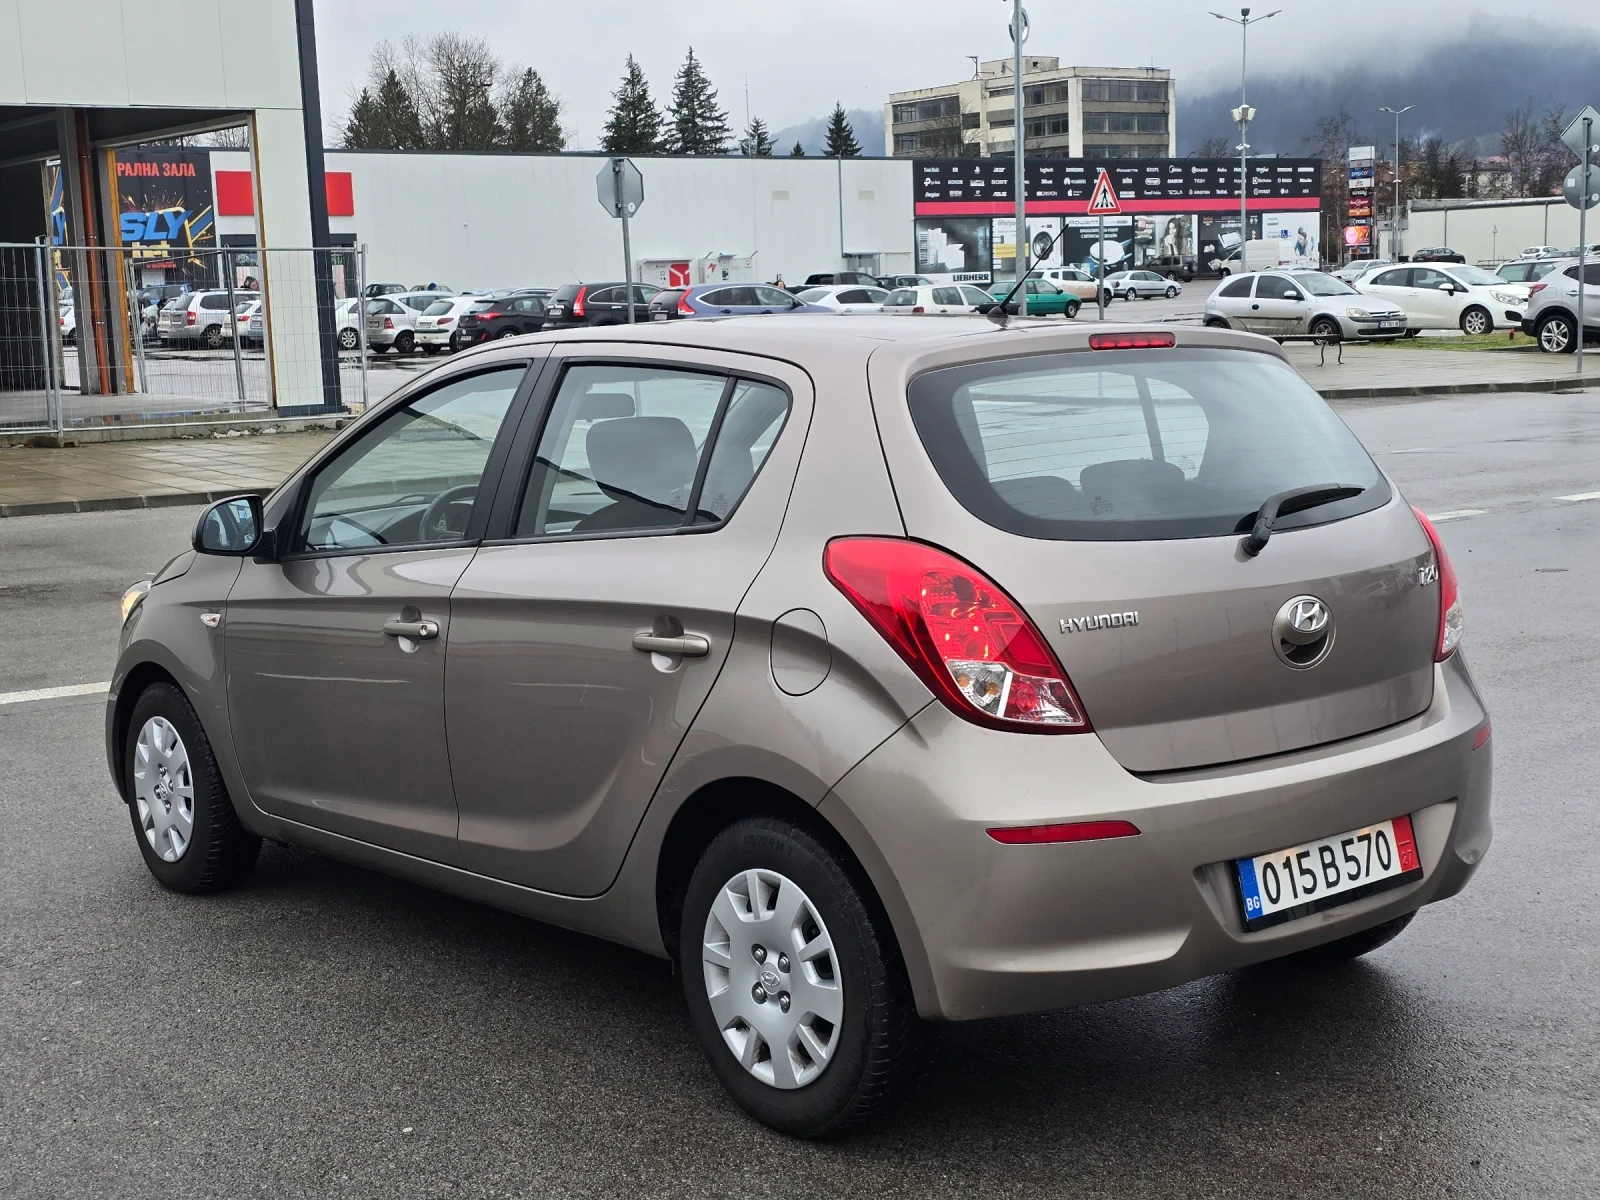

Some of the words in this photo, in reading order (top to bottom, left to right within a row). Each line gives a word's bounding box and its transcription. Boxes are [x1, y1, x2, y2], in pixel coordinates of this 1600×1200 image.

[115, 162, 160, 177] РАЛНА
[163, 162, 196, 177] ЗАЛА
[120, 209, 194, 241] SLY
[952, 273, 989, 282] LIEBHERR
[1418, 564, 1439, 586] i20
[1059, 611, 1139, 634] HYUNDAI
[1245, 896, 1261, 911] BG
